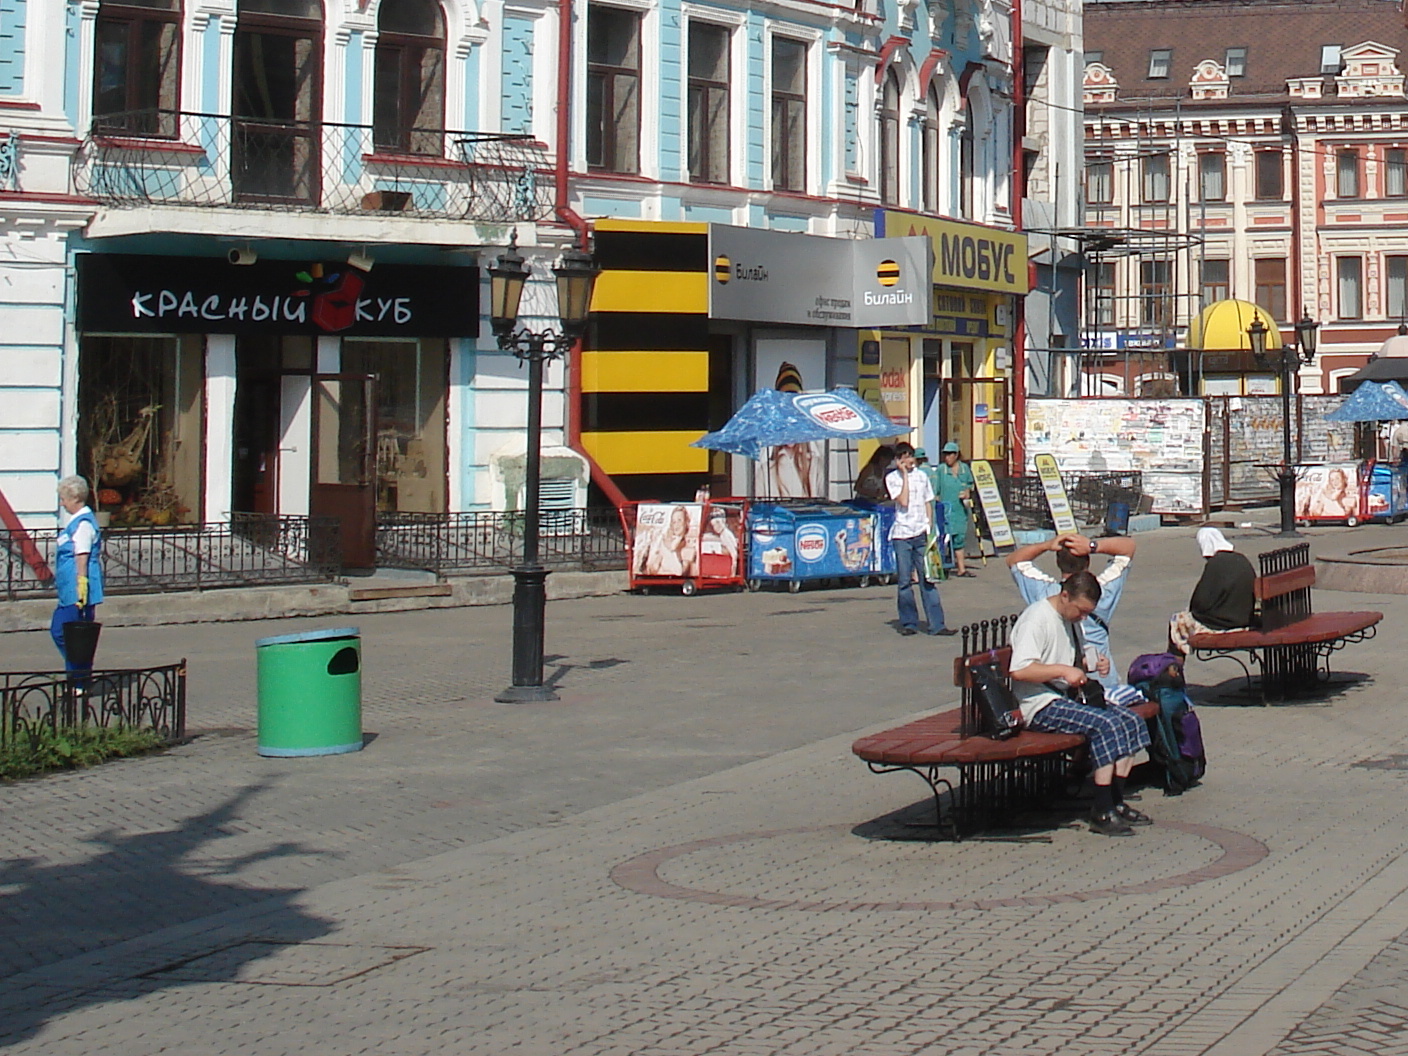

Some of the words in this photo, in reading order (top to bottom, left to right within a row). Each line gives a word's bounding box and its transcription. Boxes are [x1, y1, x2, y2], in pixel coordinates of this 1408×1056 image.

[940, 231, 1016, 285] МОБУС
[735, 263, 769, 281] Билайн
[132, 289, 306, 324] КРАСНЫЙ
[354, 297, 412, 324] КУБ
[864, 290, 913, 306] Билайн
